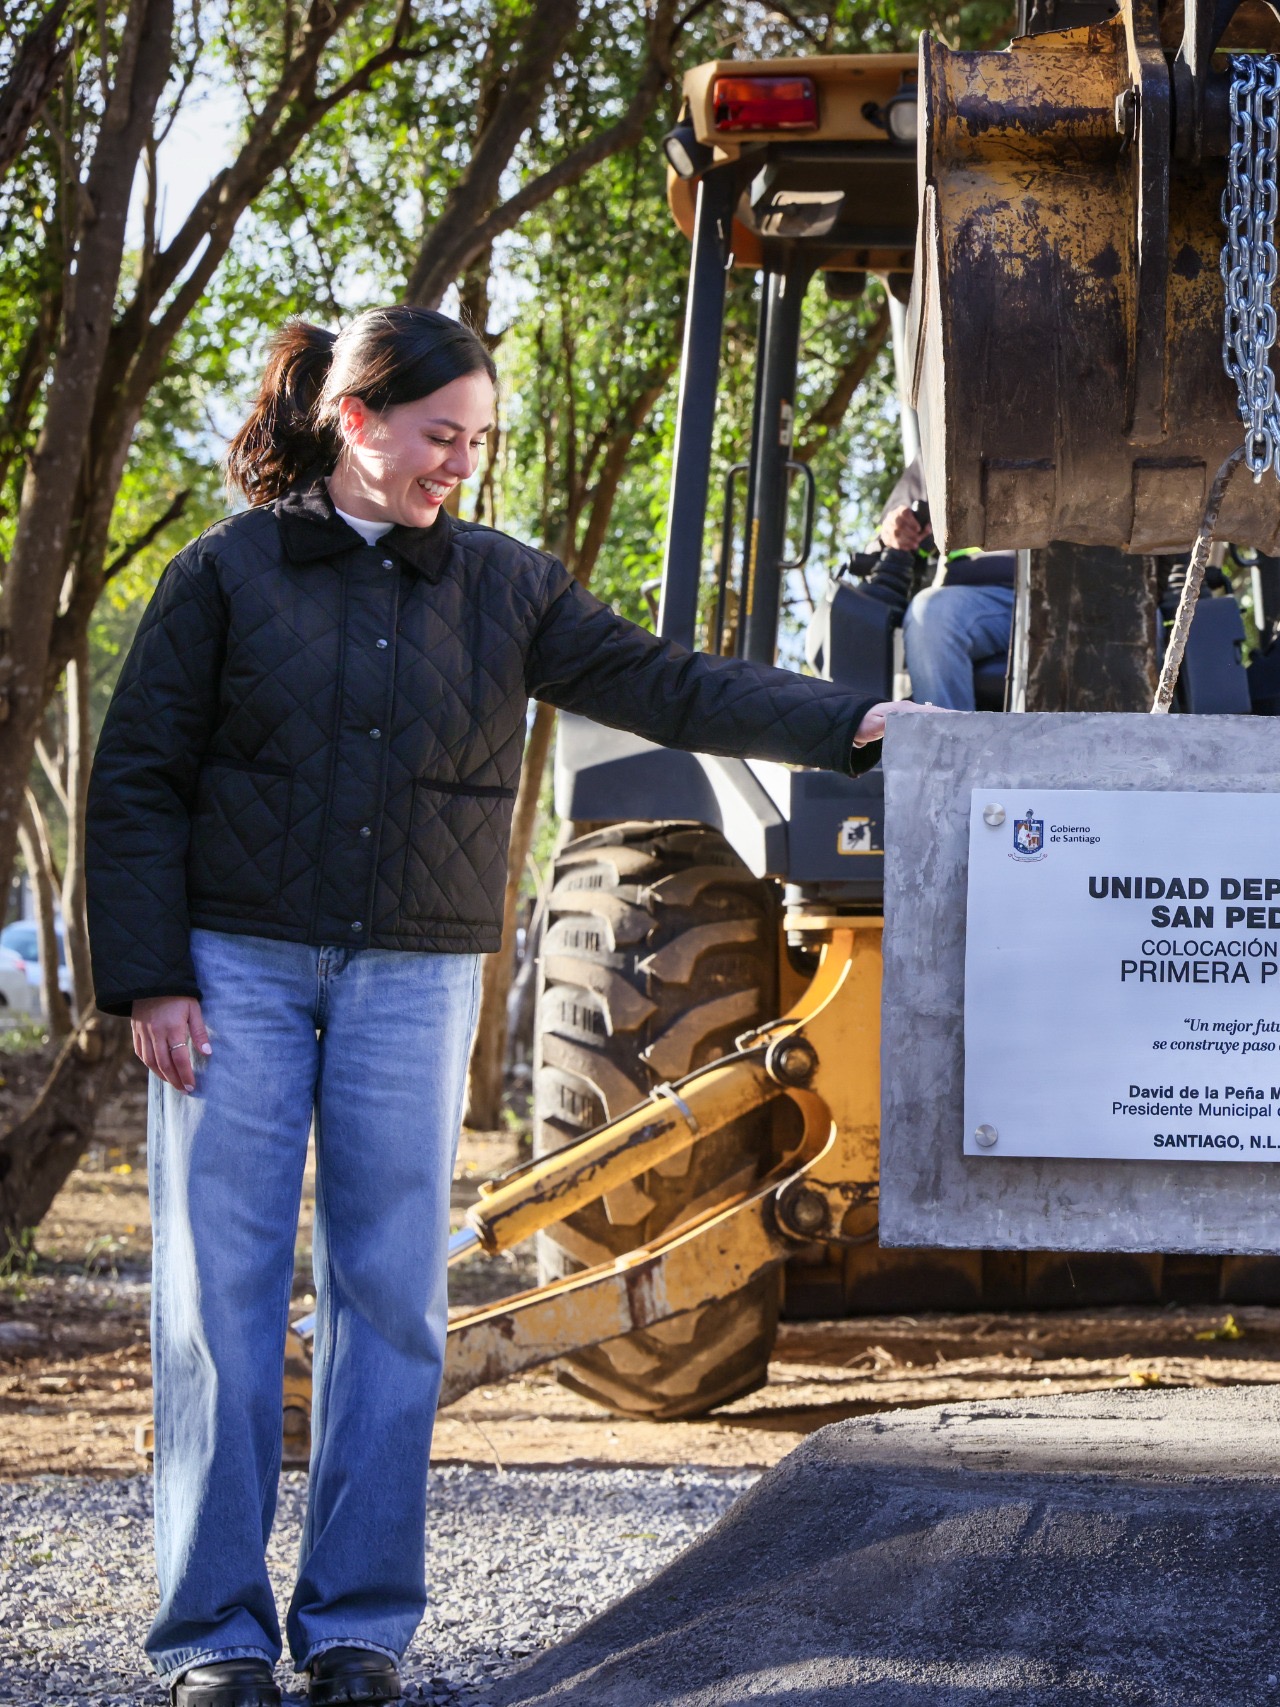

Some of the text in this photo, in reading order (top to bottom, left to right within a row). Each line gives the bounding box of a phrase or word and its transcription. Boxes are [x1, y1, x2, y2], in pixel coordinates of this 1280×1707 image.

[1050, 825, 1091, 833] Gobierno
[1050, 835, 1101, 844] de Santiago
[1088, 876, 1210, 900] UNIDAD
[1150, 905, 1215, 929] SAN
[1141, 938, 1278, 959] COLOCACIÓN
[1120, 959, 1251, 984] PRIMERA
[1212, 1018, 1253, 1036] mejor
[1152, 1040, 1168, 1051] se
[1169, 1040, 1240, 1055] construye
[1240, 1042, 1276, 1055] paso
[1129, 1085, 1174, 1100] David
[1179, 1086, 1200, 1100] de
[1205, 1086, 1219, 1100] la
[1225, 1087, 1265, 1101] Peña
[1112, 1101, 1193, 1117] Presidente
[1198, 1102, 1272, 1120] Municipal
[1153, 1134, 1245, 1151] SANTIAGO,
